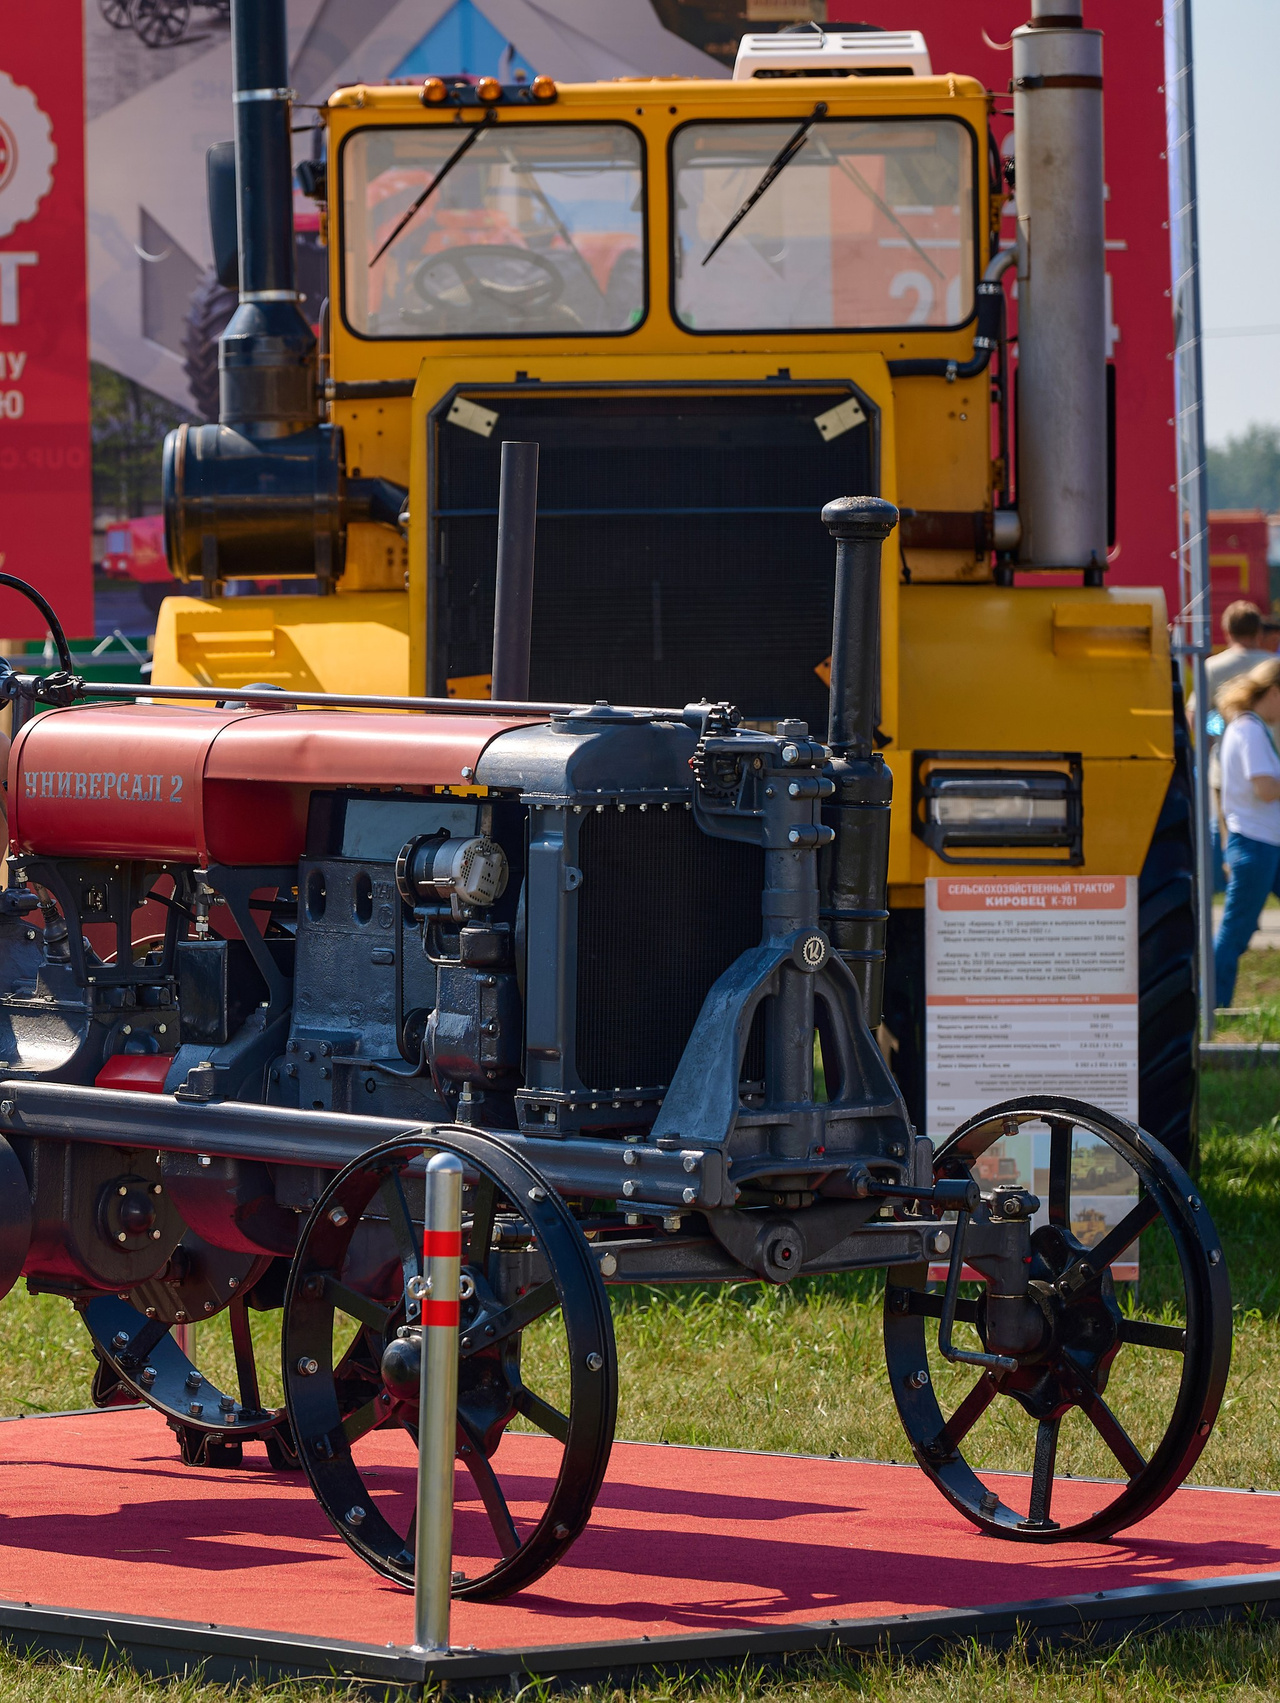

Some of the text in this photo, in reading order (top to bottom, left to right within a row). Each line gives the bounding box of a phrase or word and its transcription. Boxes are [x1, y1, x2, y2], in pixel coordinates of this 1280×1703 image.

[24, 771, 184, 803] УНИВЕРСАЛ 2
[948, 881, 1116, 895] СЕЛЬСКОХОЗЯЙСТВЕННЫЙ ТРАКТОР
[985, 896, 1078, 907] КИРОВЕЦ К-701
